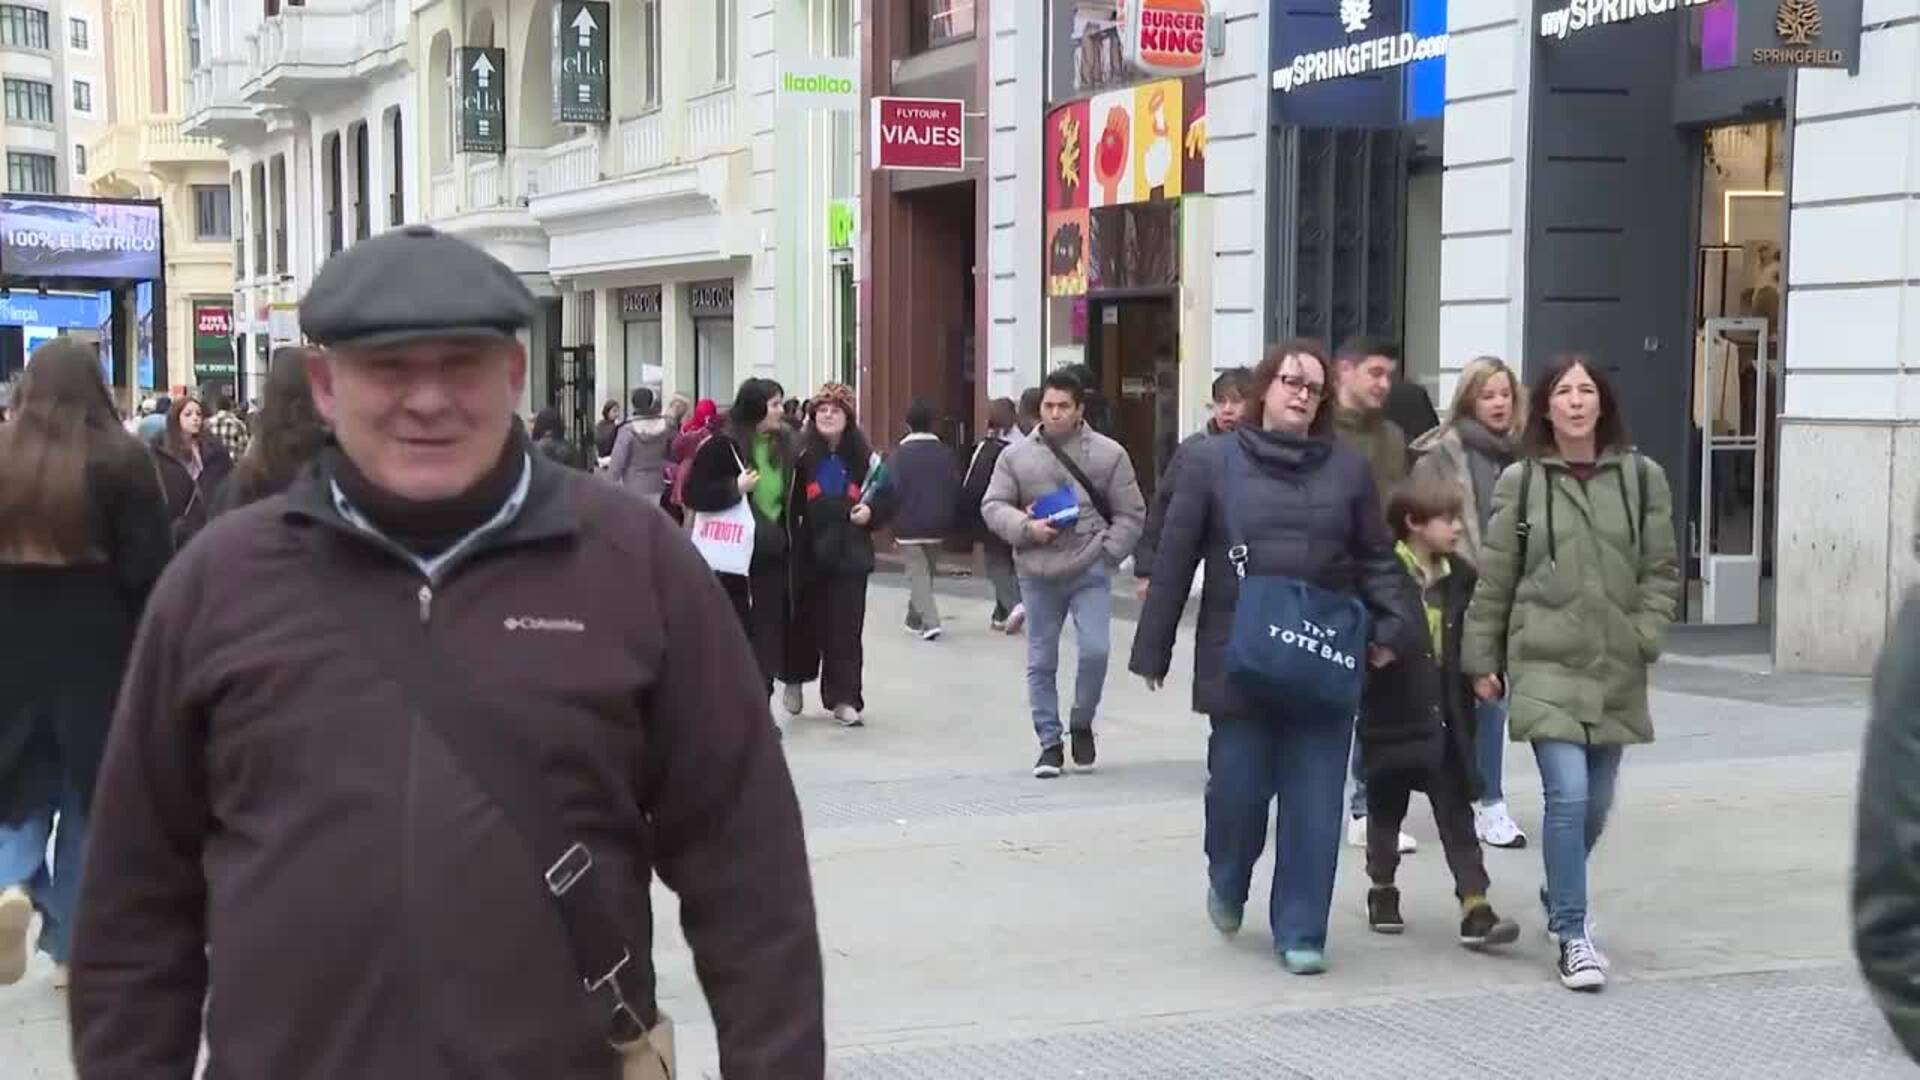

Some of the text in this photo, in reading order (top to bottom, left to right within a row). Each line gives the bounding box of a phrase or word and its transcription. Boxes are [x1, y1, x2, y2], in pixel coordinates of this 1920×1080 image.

[1142, 10, 1204, 31] BURGER
[1141, 28, 1204, 54] KING
[563, 51, 605, 75] ella
[1753, 47, 1843, 63] SPRINGFIELD
[896, 107, 940, 119] FLYTOUR
[882, 124, 961, 146] VIAJES
[8, 230, 54, 249] 100%
[199, 323, 228, 332] GUYS
[1269, 624, 1356, 670] TOTE BAG
